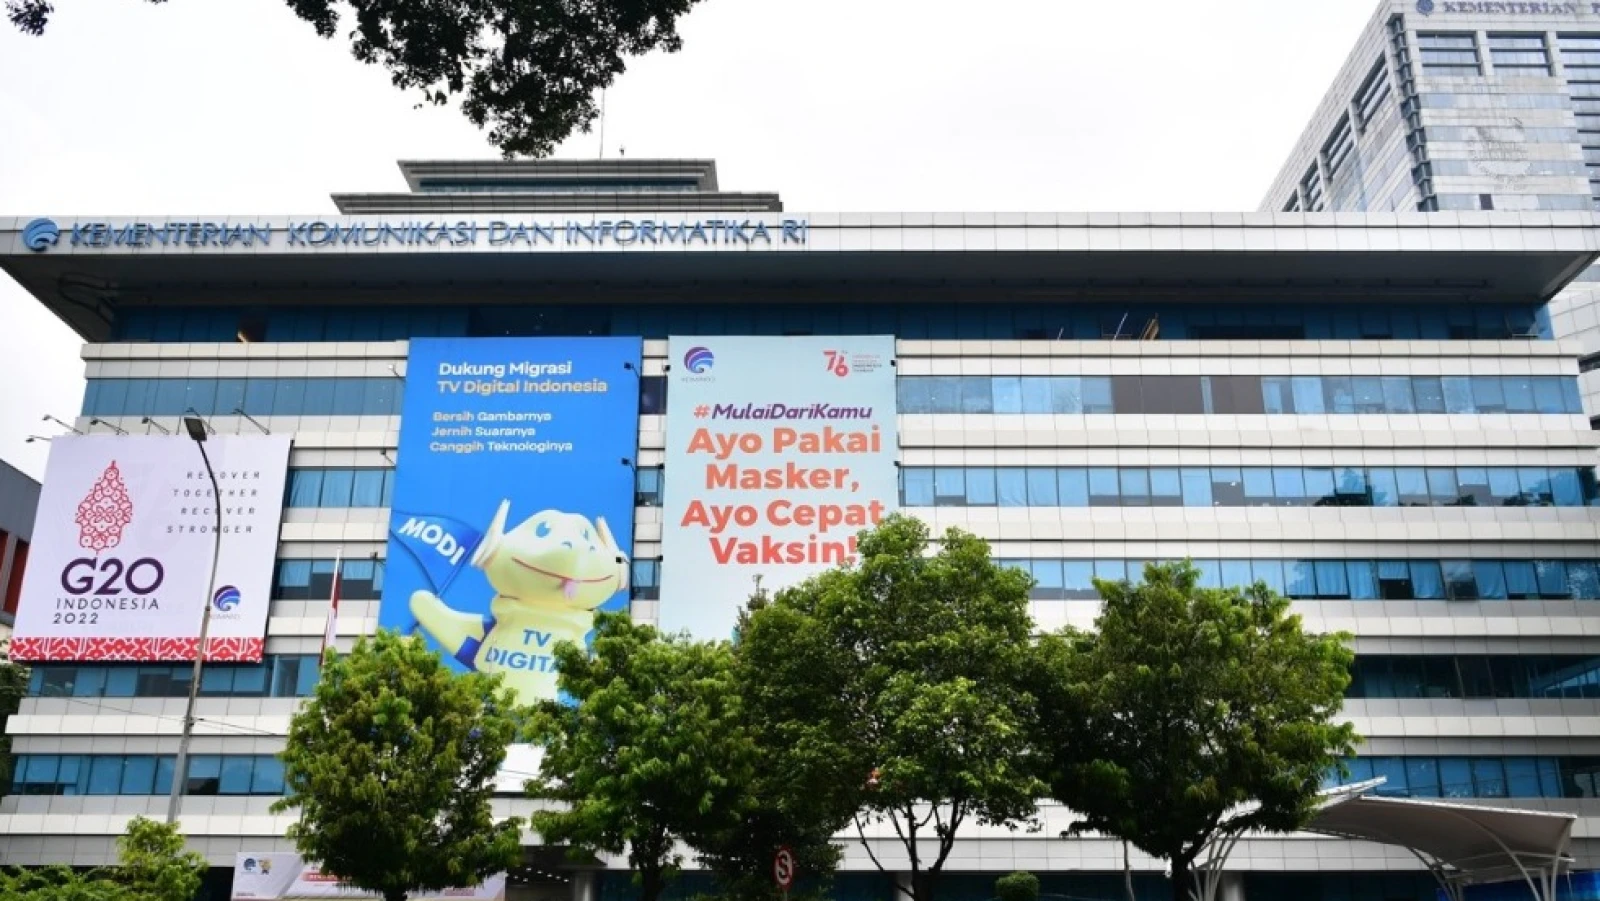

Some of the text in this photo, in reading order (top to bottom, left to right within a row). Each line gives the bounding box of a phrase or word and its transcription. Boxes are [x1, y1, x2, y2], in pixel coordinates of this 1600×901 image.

[1443, 1, 1577, 14] KEMENTERIAN
[70, 219, 808, 247] KEMENTERIAN KOMUNIKASI DAN INFORMATIKA RI
[439, 361, 573, 377] Dukung Migrasi
[437, 378, 608, 396] TV Digital Indonesia
[432, 411, 552, 422] Bersih Gambarnya
[694, 403, 872, 420] #MulaiDariKamu
[431, 426, 536, 437] Jernih Suaranya
[429, 441, 573, 453] Canggih Teknologinya
[686, 425, 881, 460] Ayo Pakai
[186, 471, 260, 480] REOVER
[705, 462, 860, 493] Masker,
[681, 499, 885, 534] Ayo Cepat
[398, 517, 465, 566] MODI
[709, 534, 857, 566] Vaksin!
[61, 557, 165, 596] G20
[56, 597, 160, 611] INDONESIA
[53, 612, 99, 625] 2022
[522, 628, 553, 648] TV
